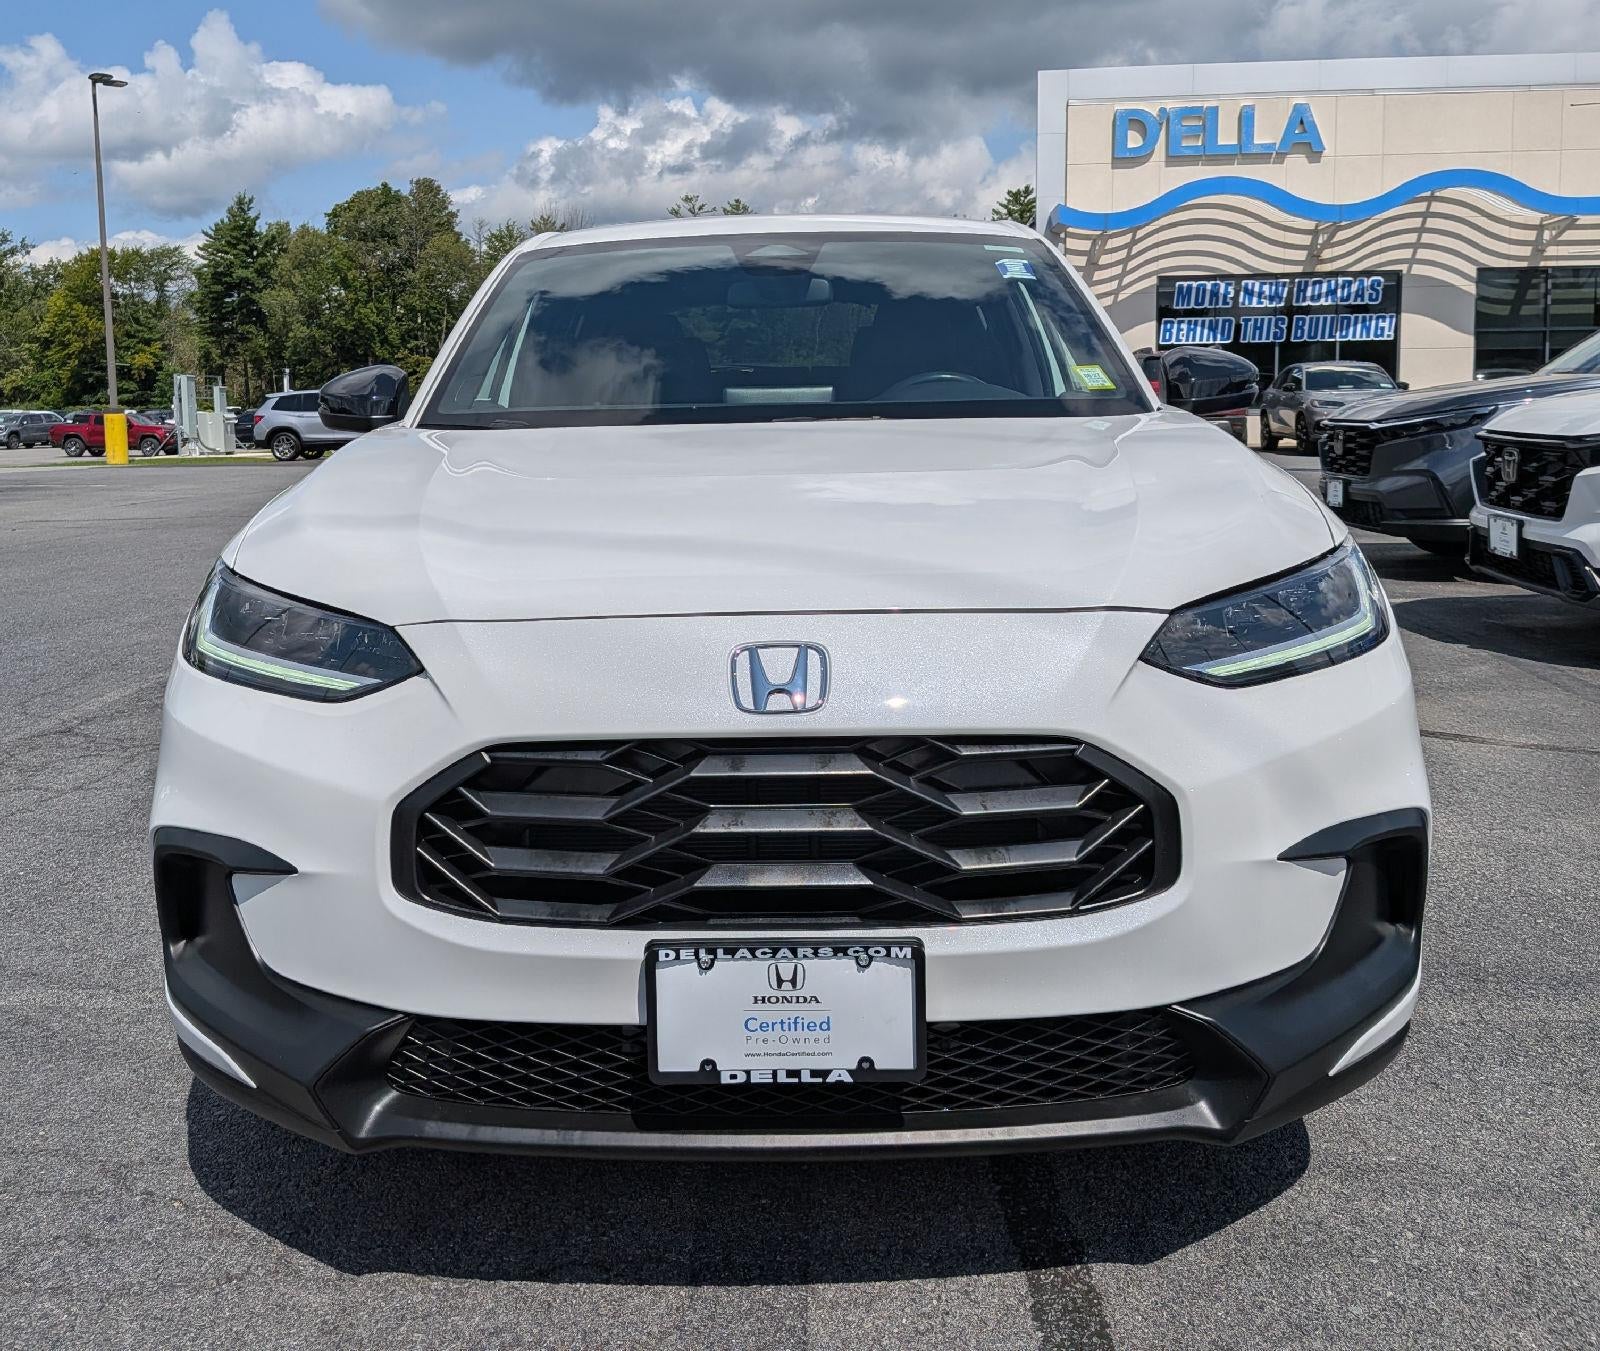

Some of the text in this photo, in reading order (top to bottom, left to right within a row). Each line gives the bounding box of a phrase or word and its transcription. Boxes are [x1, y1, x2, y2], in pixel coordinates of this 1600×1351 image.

[1113, 102, 1326, 159] D'ELLA
[1174, 276, 1384, 308] MORE NEW HONDAS
[1160, 313, 1396, 344] BEHIND THIS BUILDING!
[658, 946, 912, 961] DELLACARS.COM
[751, 995, 822, 1005] HONDA
[743, 1015, 831, 1033] Certified
[745, 1034, 831, 1045] Pre-Owned
[720, 1069, 854, 1085] DELLA
